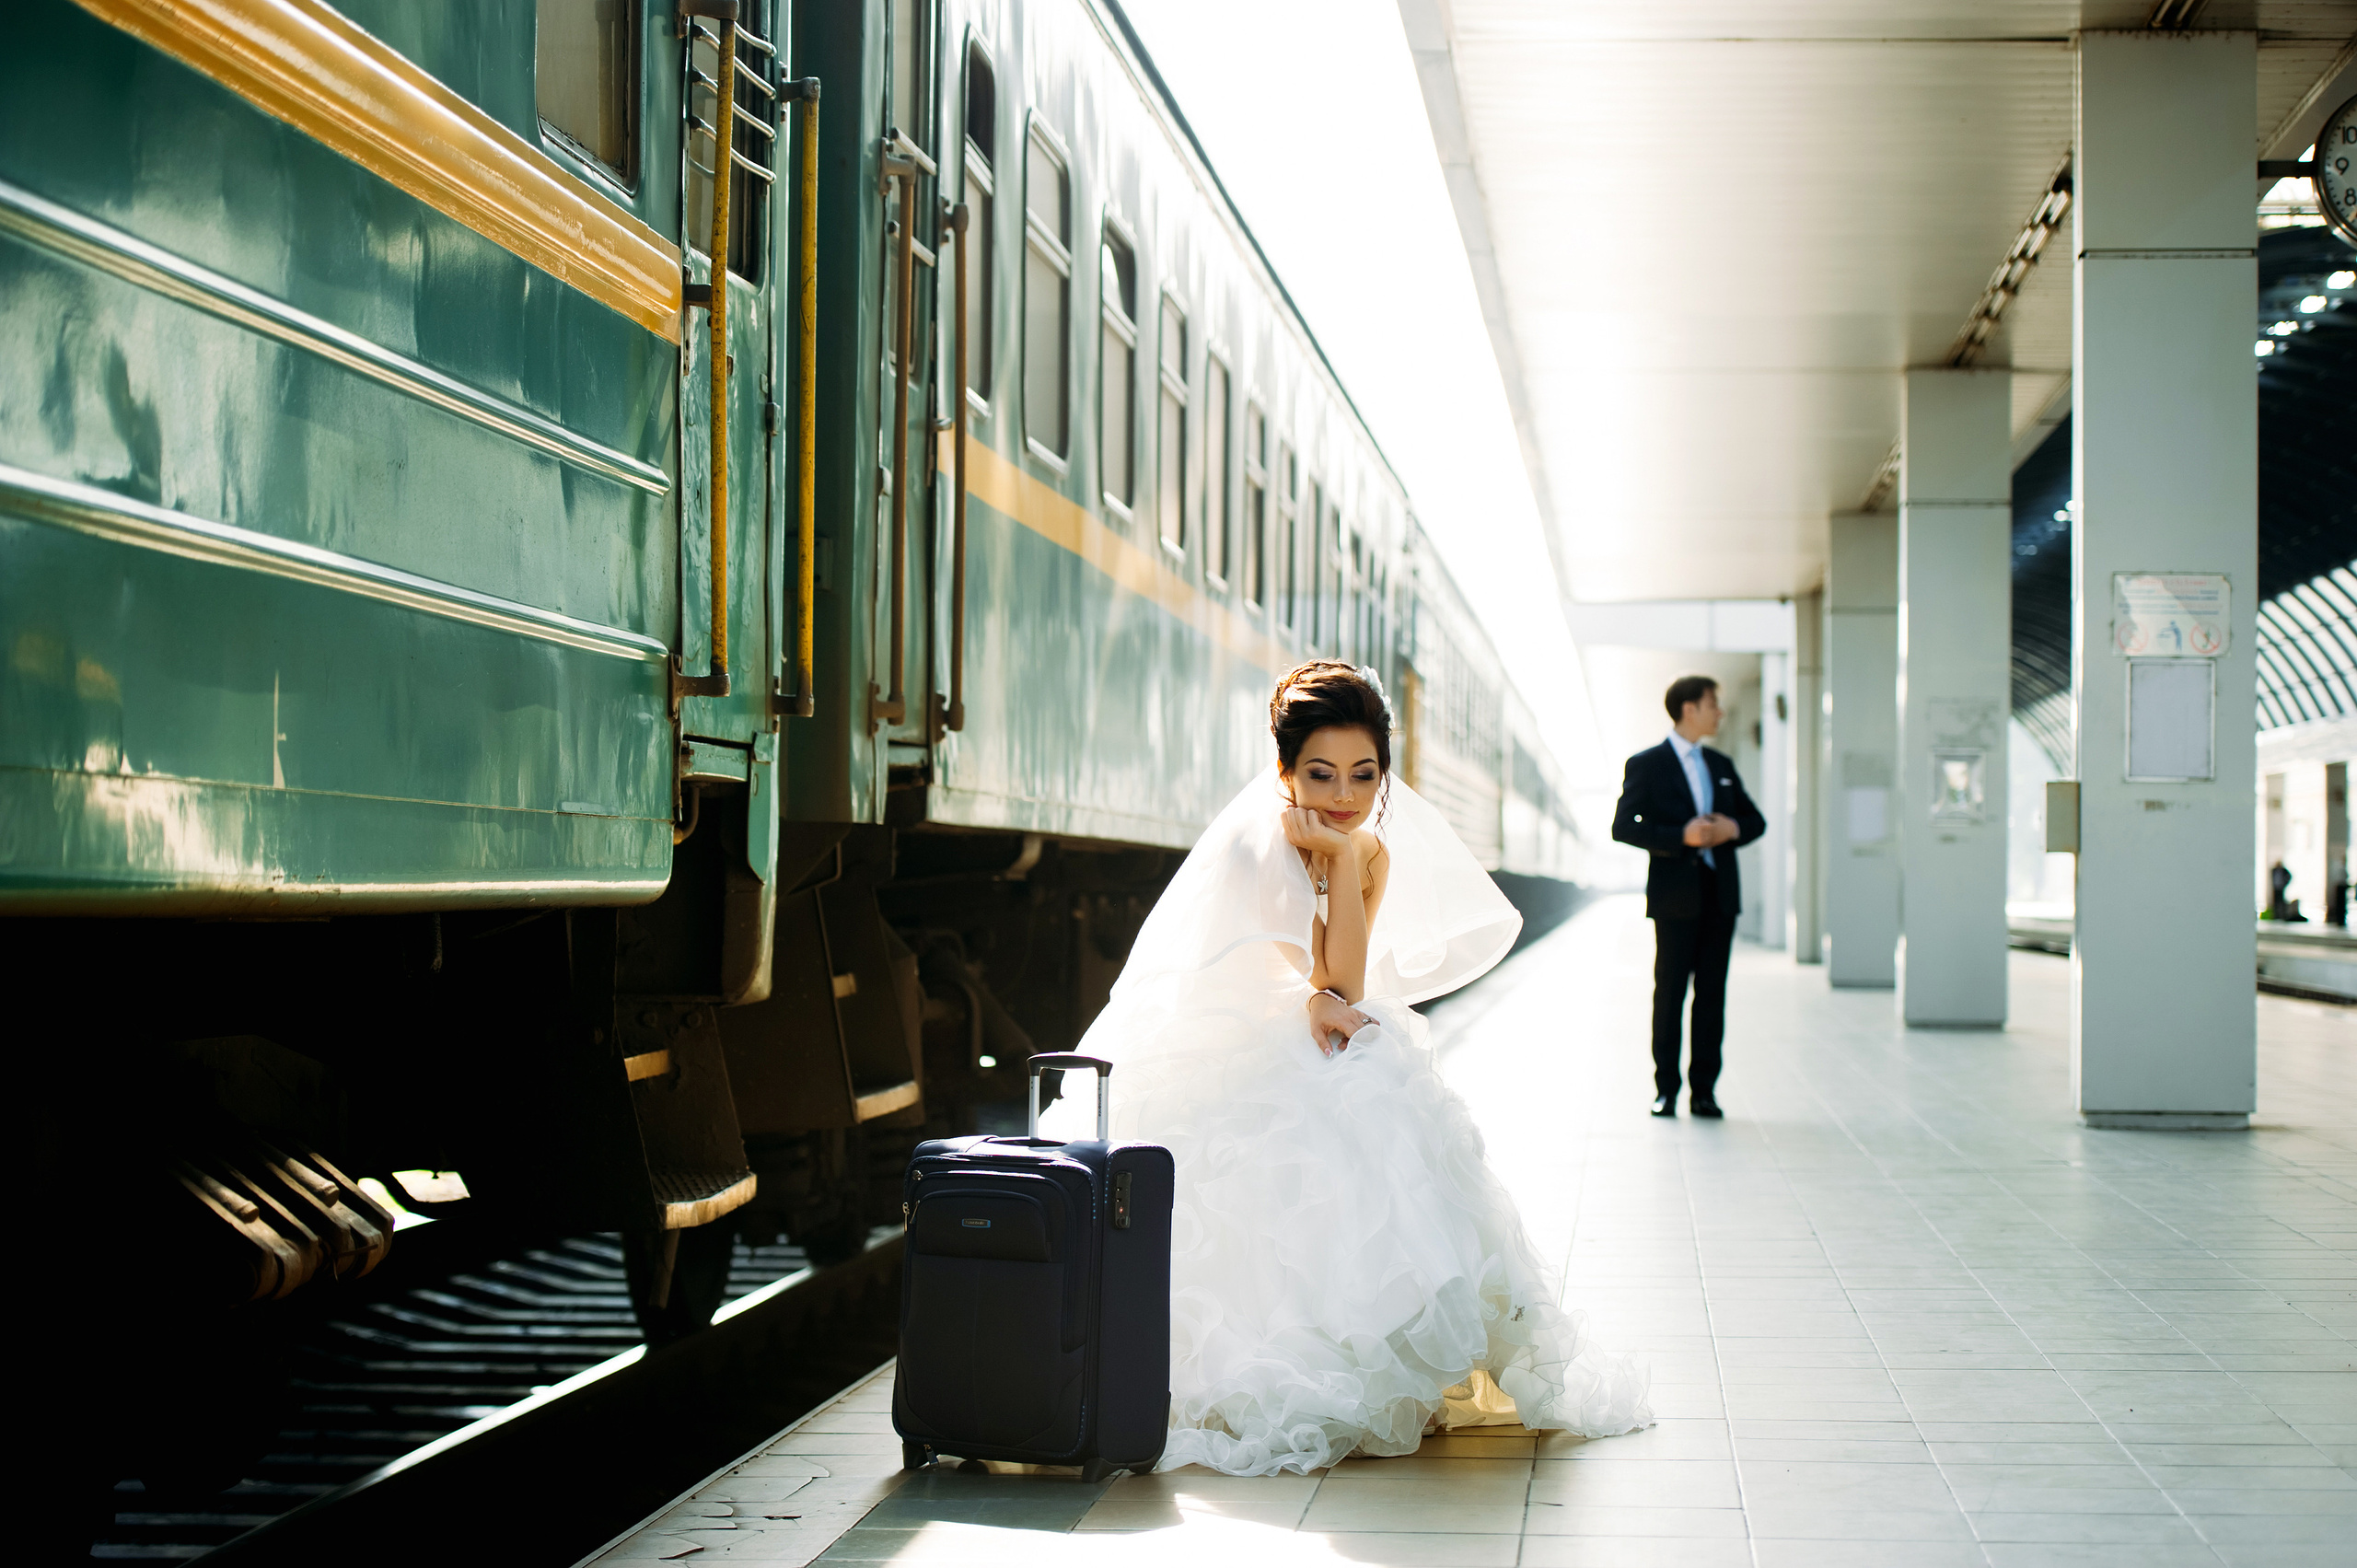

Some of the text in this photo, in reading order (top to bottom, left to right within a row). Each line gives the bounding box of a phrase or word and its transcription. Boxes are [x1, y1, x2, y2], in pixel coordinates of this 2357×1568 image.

[2342, 126, 2357, 145] 10
[2336, 157, 2349, 175] 9
[2345, 188, 2356, 205] 8
